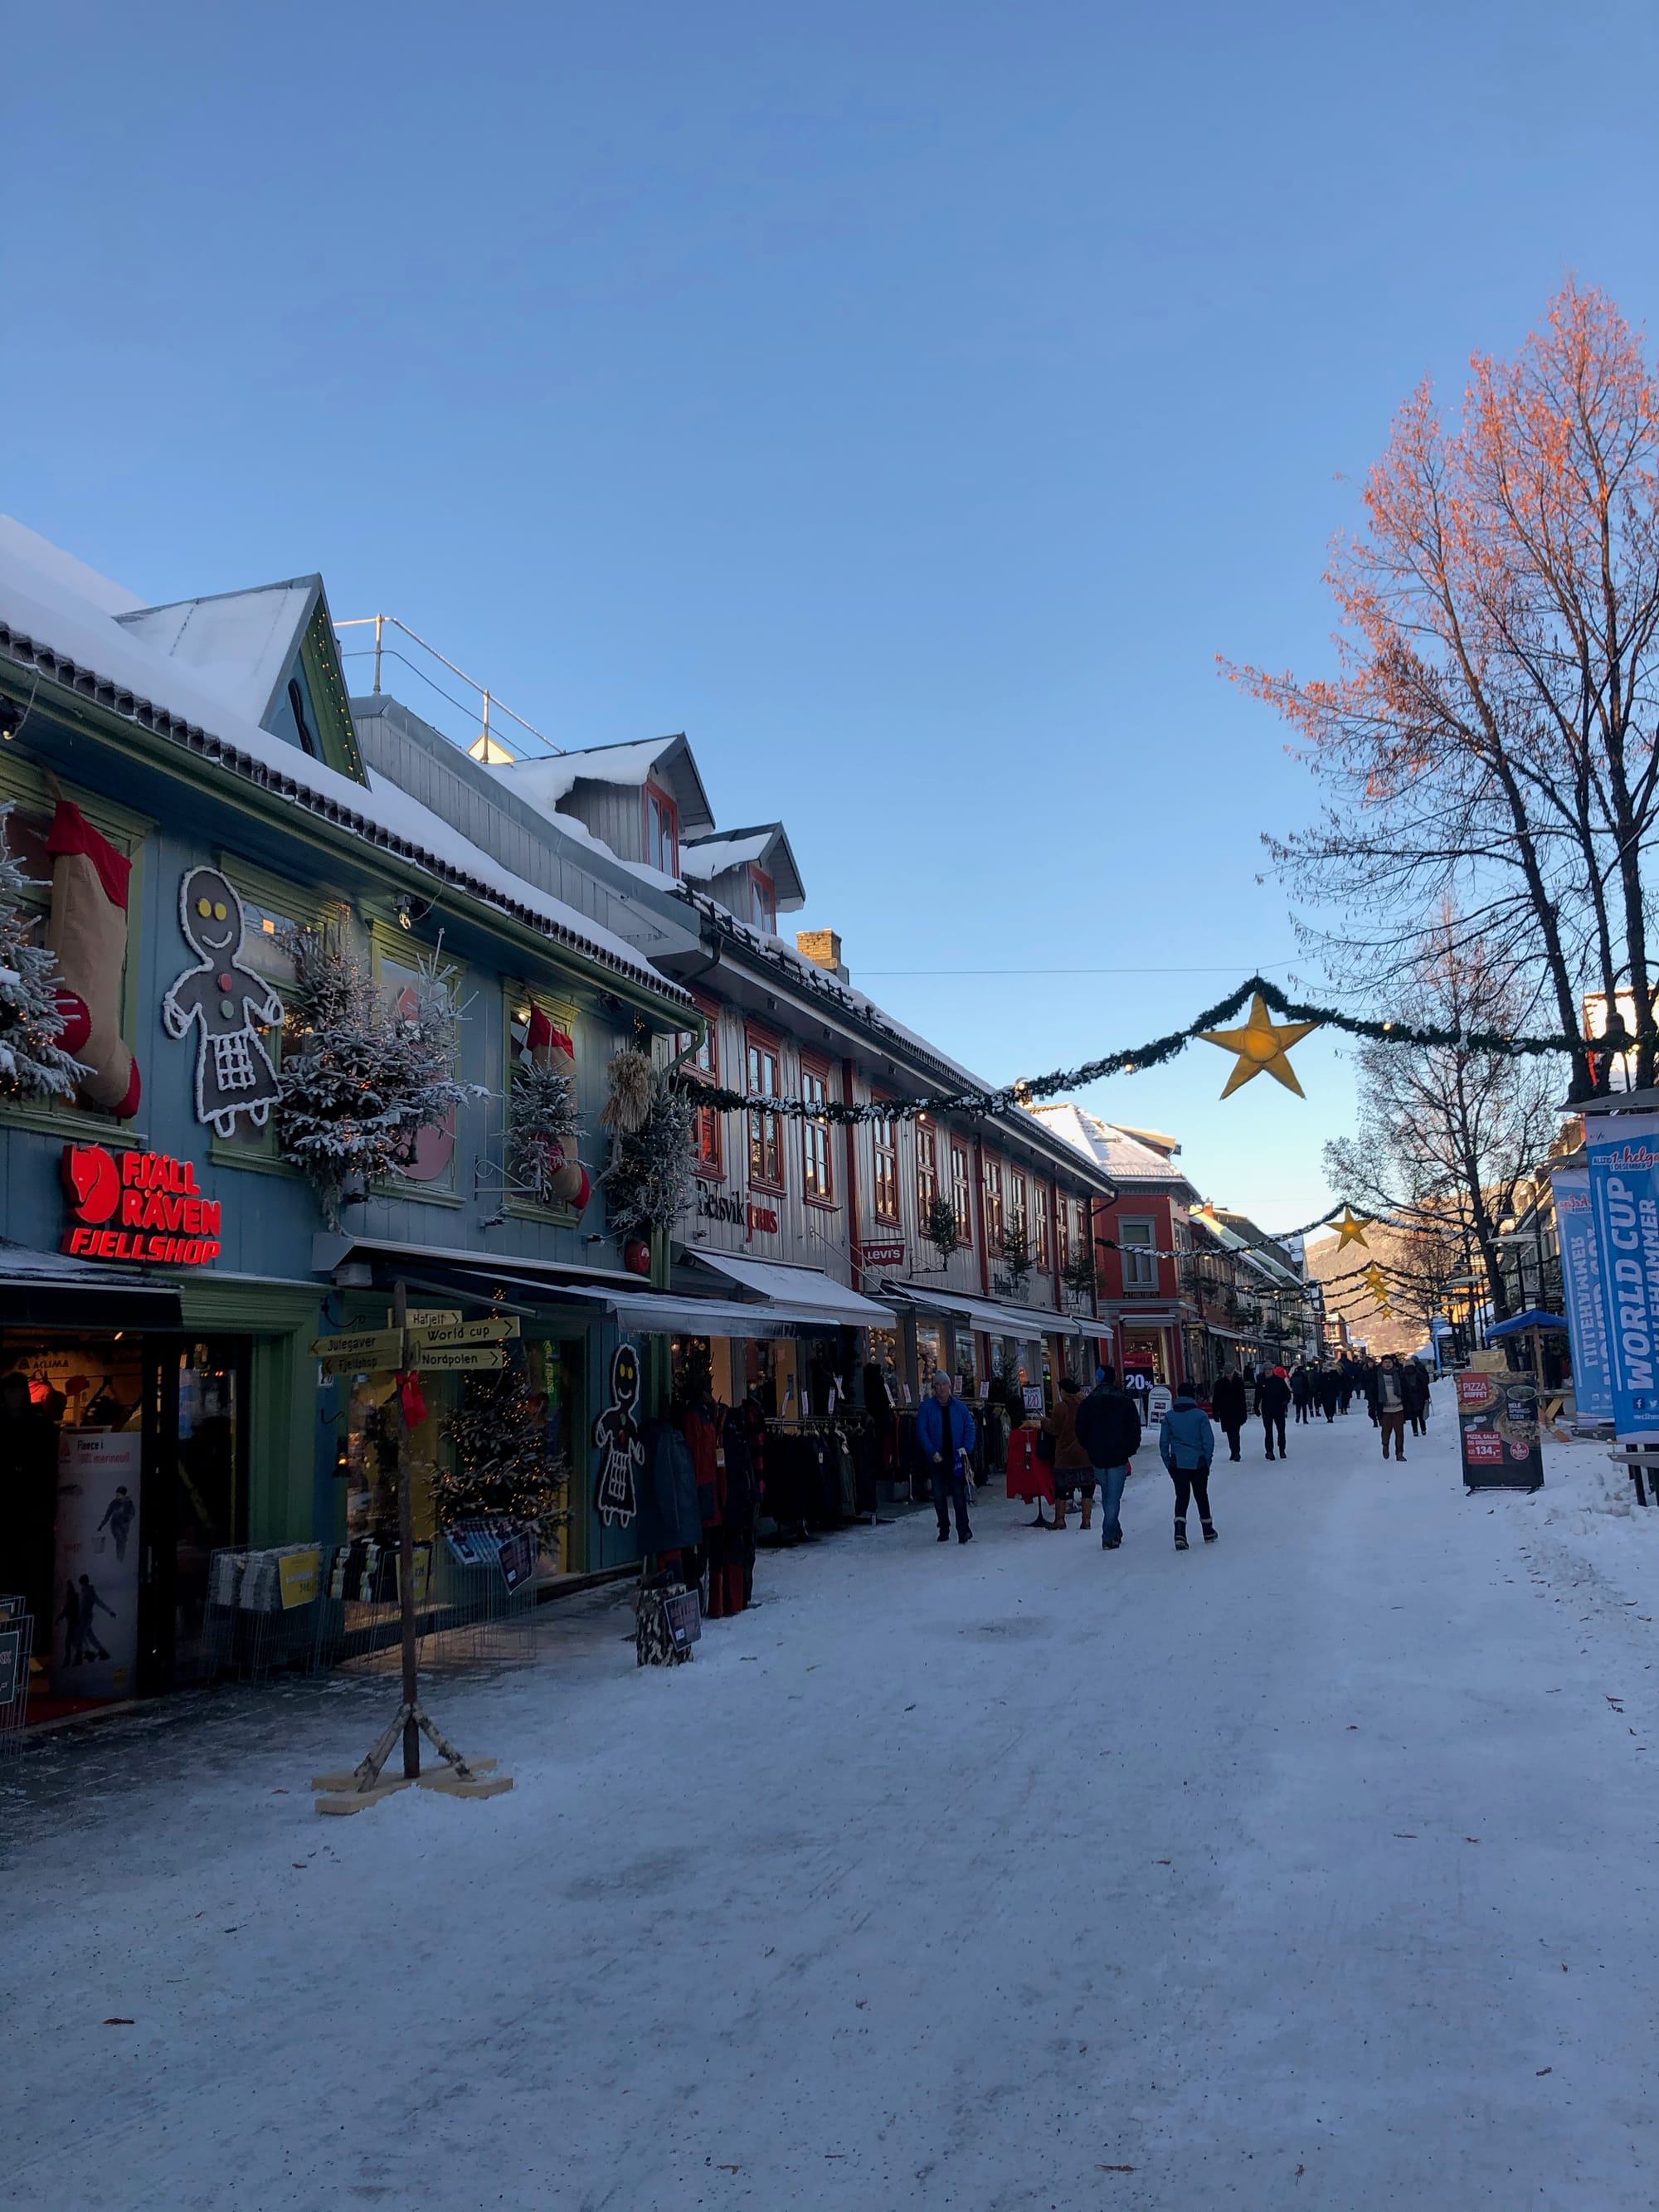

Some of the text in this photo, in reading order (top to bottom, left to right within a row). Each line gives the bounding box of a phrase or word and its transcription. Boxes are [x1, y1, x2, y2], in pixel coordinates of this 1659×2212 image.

[122, 1150, 201, 1196] FJÄLL
[122, 1189, 221, 1236] RÄVEN
[1607, 1176, 1639, 1251] CUP
[69, 1228, 221, 1265] FJELLSHOP
[427, 1326, 489, 1341] World cup
[1614, 1258, 1654, 1390] WORLD
[328, 1336, 376, 1352] Julegaver
[422, 1354, 478, 1364] Nordpolen
[1125, 1373, 1154, 1390] 20%
[1462, 1383, 1486, 1391] PIZZA
